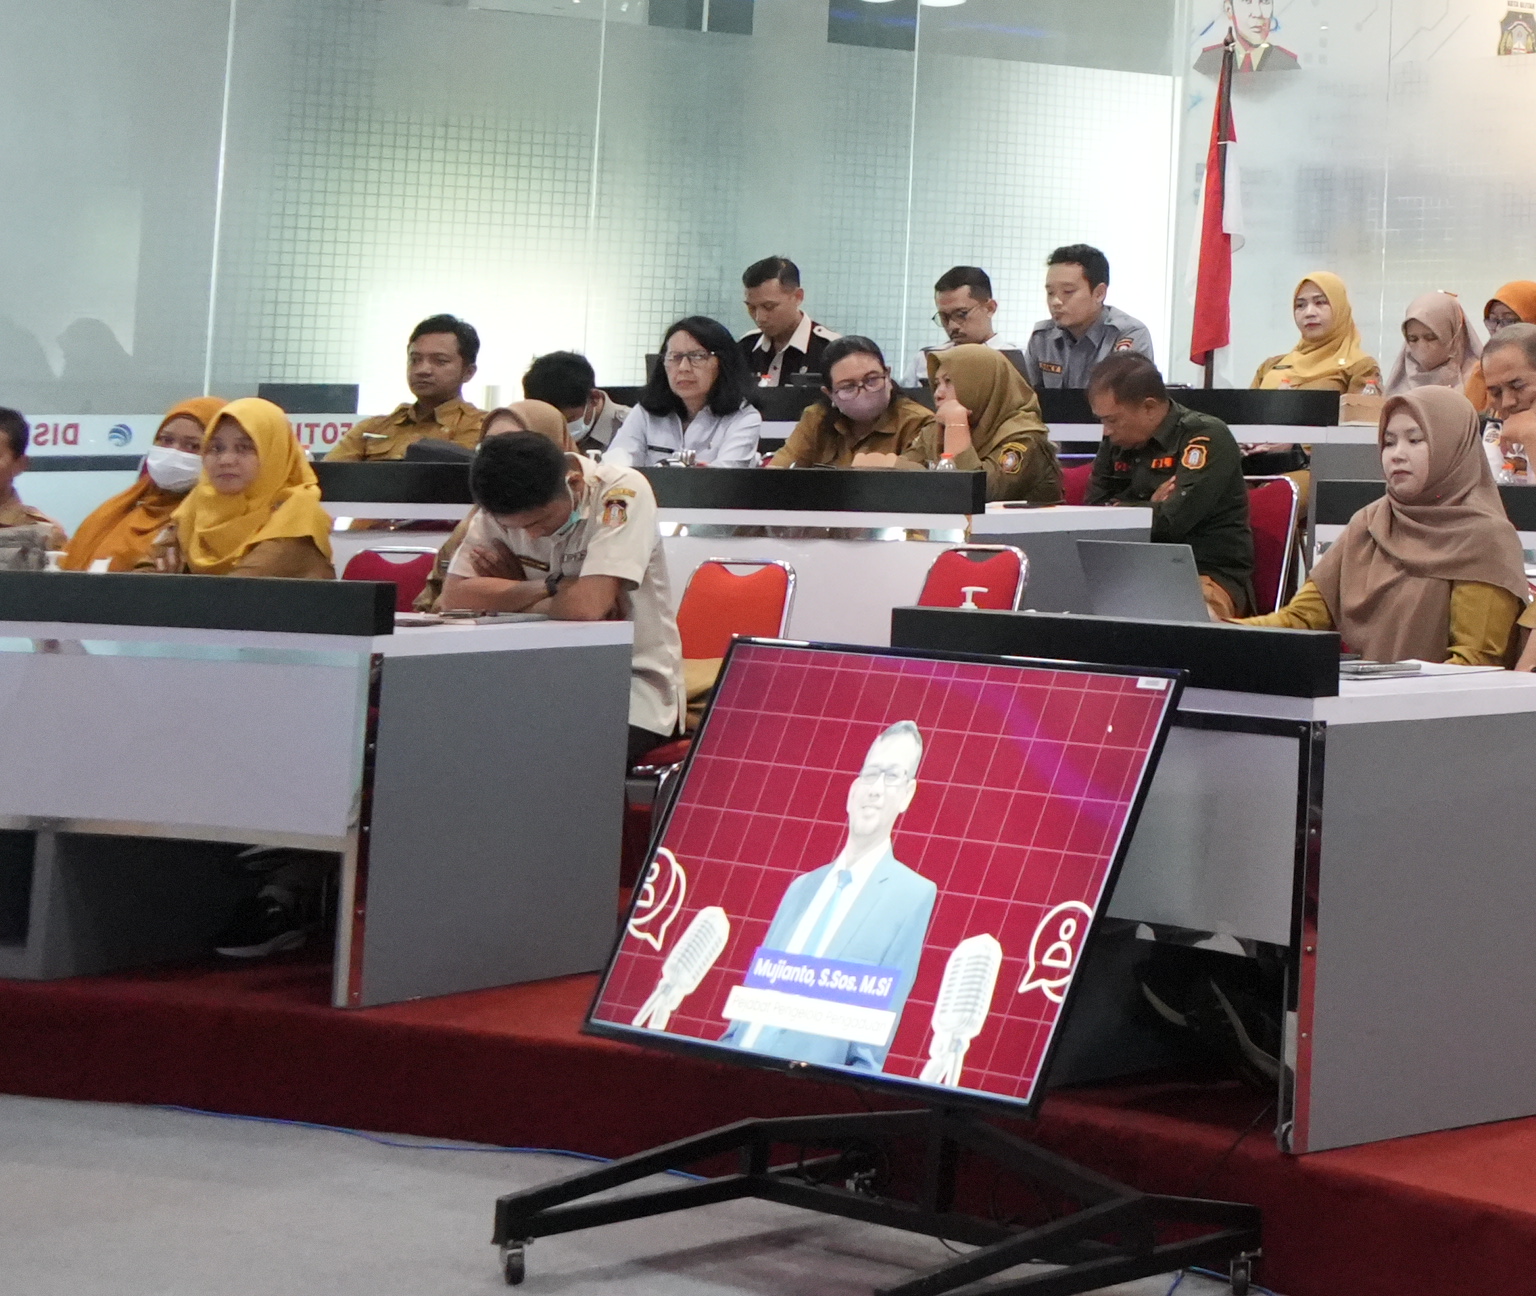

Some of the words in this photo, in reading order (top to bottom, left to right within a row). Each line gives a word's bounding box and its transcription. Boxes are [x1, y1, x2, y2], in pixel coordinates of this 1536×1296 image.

[754, 958, 817, 987] Mujianto,
[818, 968, 858, 991] S.Sos.
[859, 975, 893, 996] M.Si
